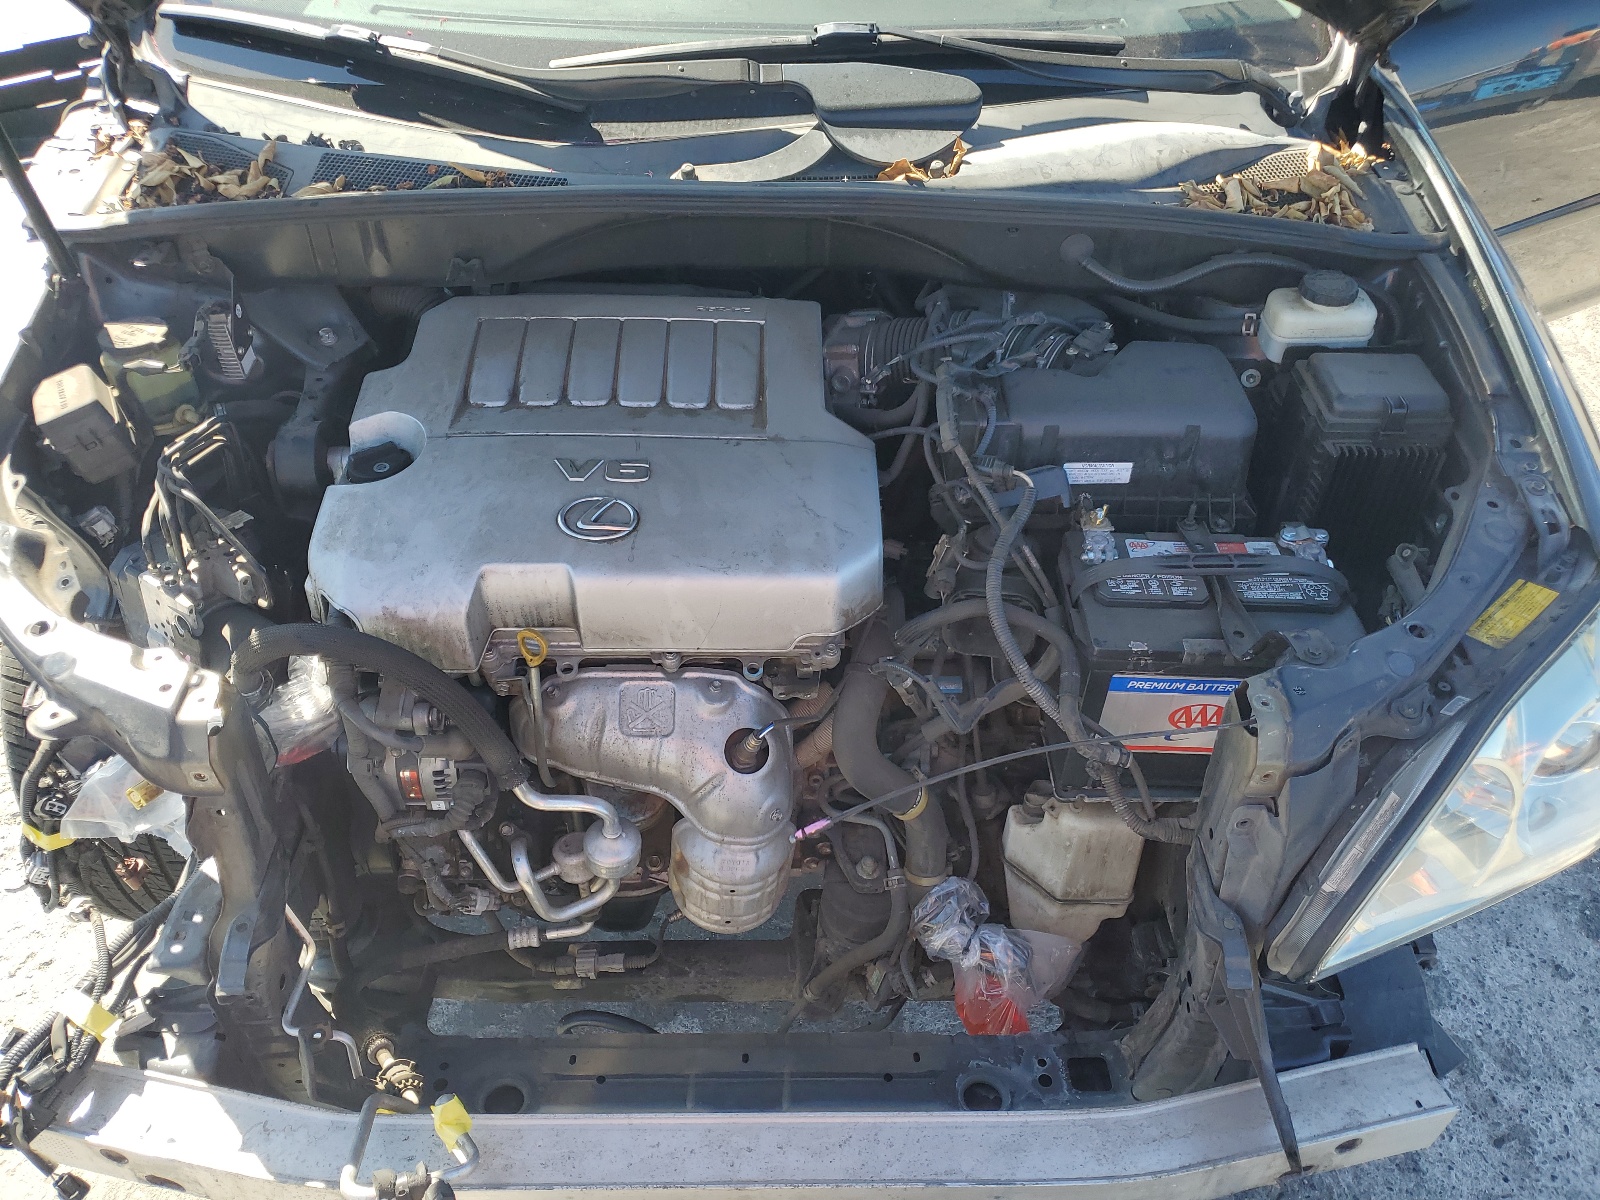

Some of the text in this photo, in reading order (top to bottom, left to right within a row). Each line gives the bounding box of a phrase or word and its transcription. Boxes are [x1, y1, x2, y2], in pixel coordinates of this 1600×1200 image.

[553, 457, 650, 482] V6
[1127, 680, 1239, 692] PREMIUM BATTER
[1170, 704, 1224, 729] AAA
